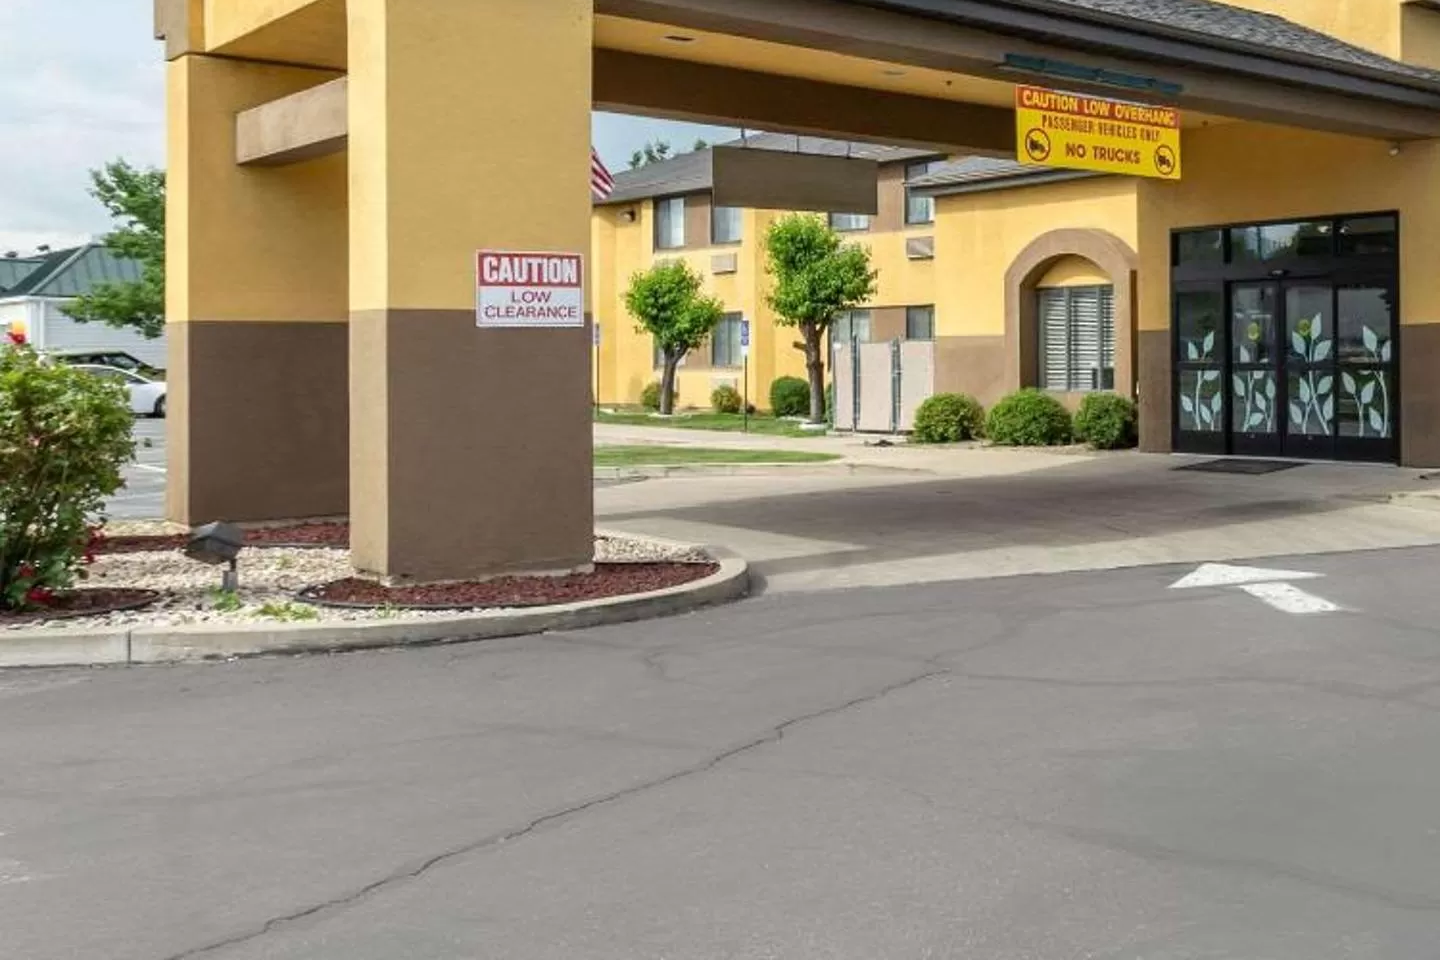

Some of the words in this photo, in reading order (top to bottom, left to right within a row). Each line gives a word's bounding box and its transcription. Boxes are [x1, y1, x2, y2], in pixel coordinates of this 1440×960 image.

[1023, 89, 1078, 112] CAUTION
[1084, 99, 1110, 116] LOW
[1115, 105, 1175, 125] OVERHANG
[1065, 143, 1086, 157] NO
[1092, 145, 1141, 164] TRUCKS
[482, 256, 577, 284] CAUTION
[511, 290, 552, 304] LOW
[484, 305, 578, 319] CLEARANCE
